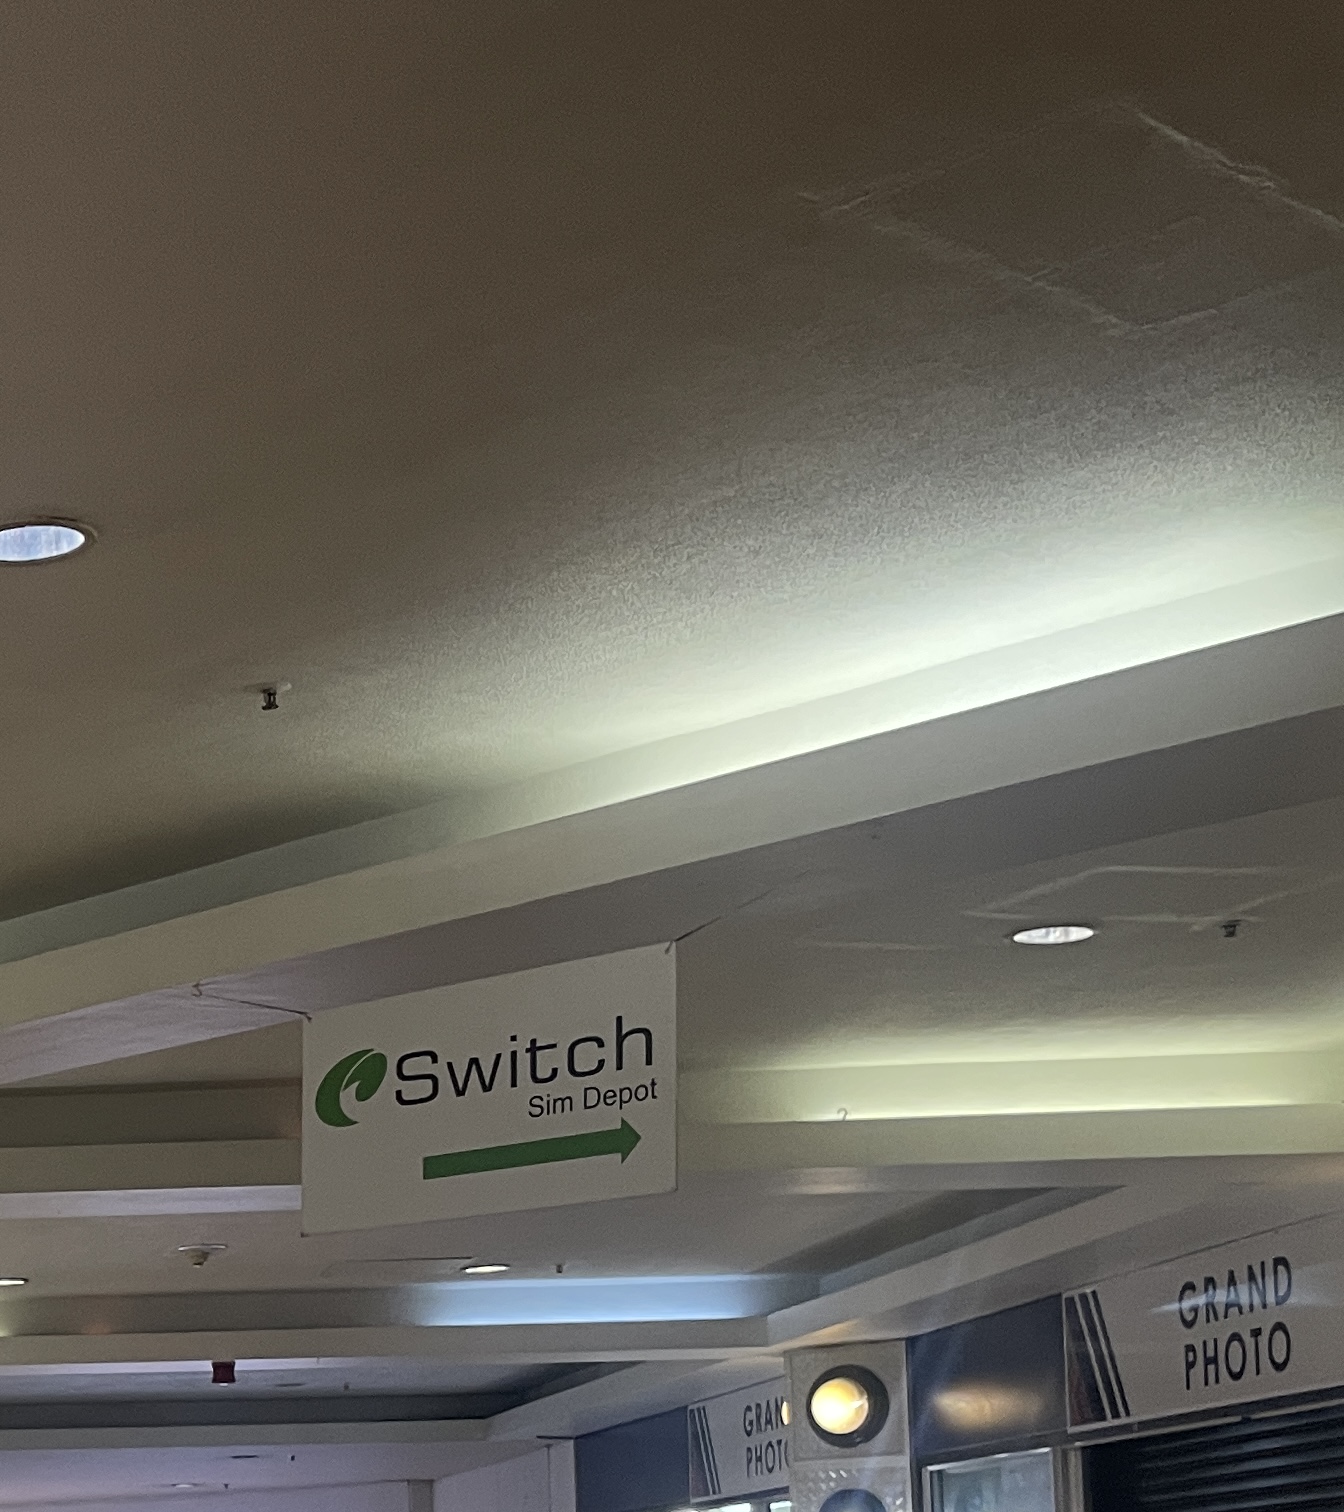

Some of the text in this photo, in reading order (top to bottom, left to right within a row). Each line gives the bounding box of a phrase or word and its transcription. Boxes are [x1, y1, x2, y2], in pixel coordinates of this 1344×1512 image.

[395, 1015, 654, 1107] Switch
[528, 1078, 658, 1119] Sim Depot
[1178, 1256, 1292, 1329] GRAND
[1184, 1321, 1292, 1391] PHOTO
[743, 1396, 786, 1437] GRAN
